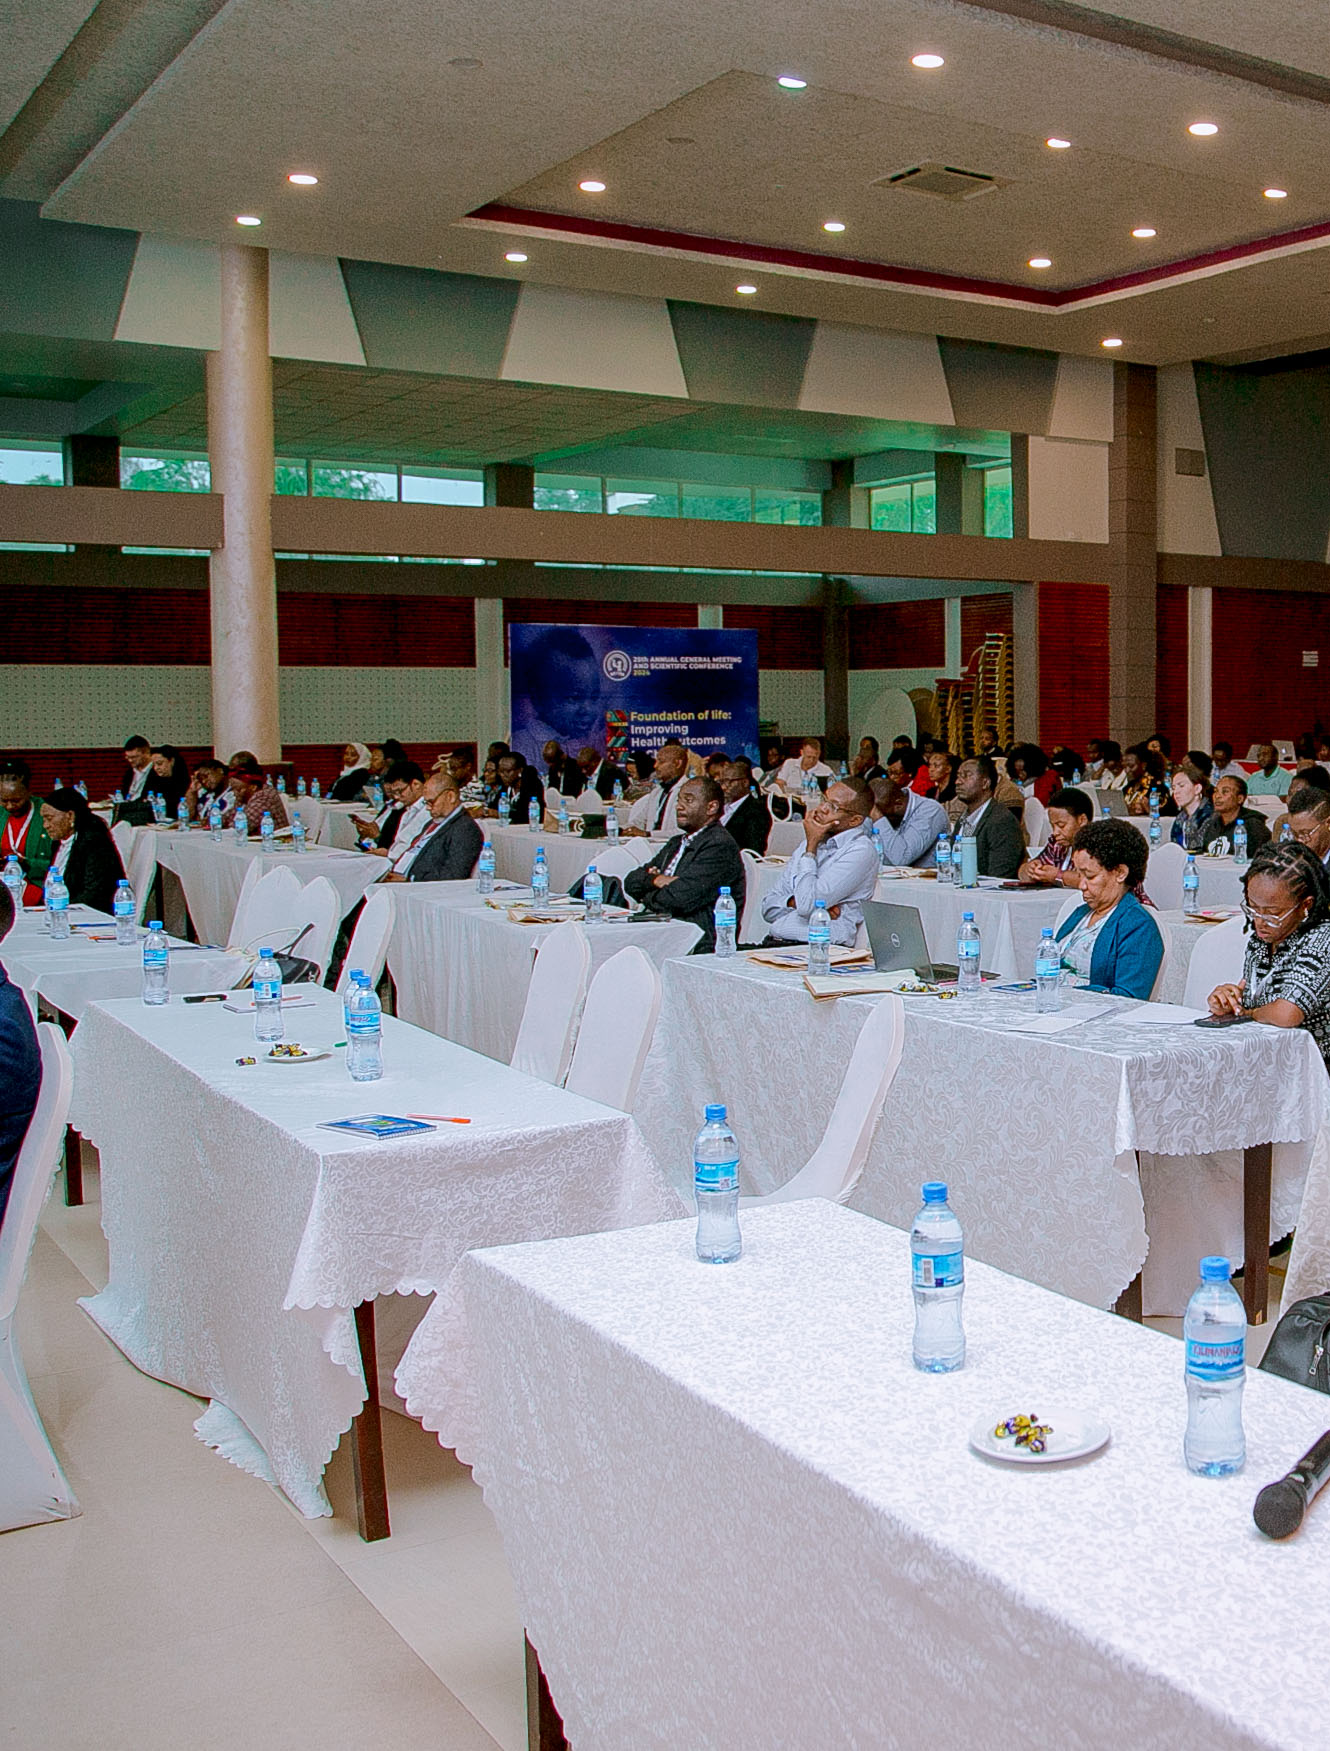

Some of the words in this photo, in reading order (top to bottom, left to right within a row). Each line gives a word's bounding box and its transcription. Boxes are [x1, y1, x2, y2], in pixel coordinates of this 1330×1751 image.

[712, 656, 742, 664] MEETING
[630, 710, 695, 721] Foundation
[697, 709, 709, 720] of
[711, 709, 732, 720] life:
[630, 723, 689, 736] Improving
